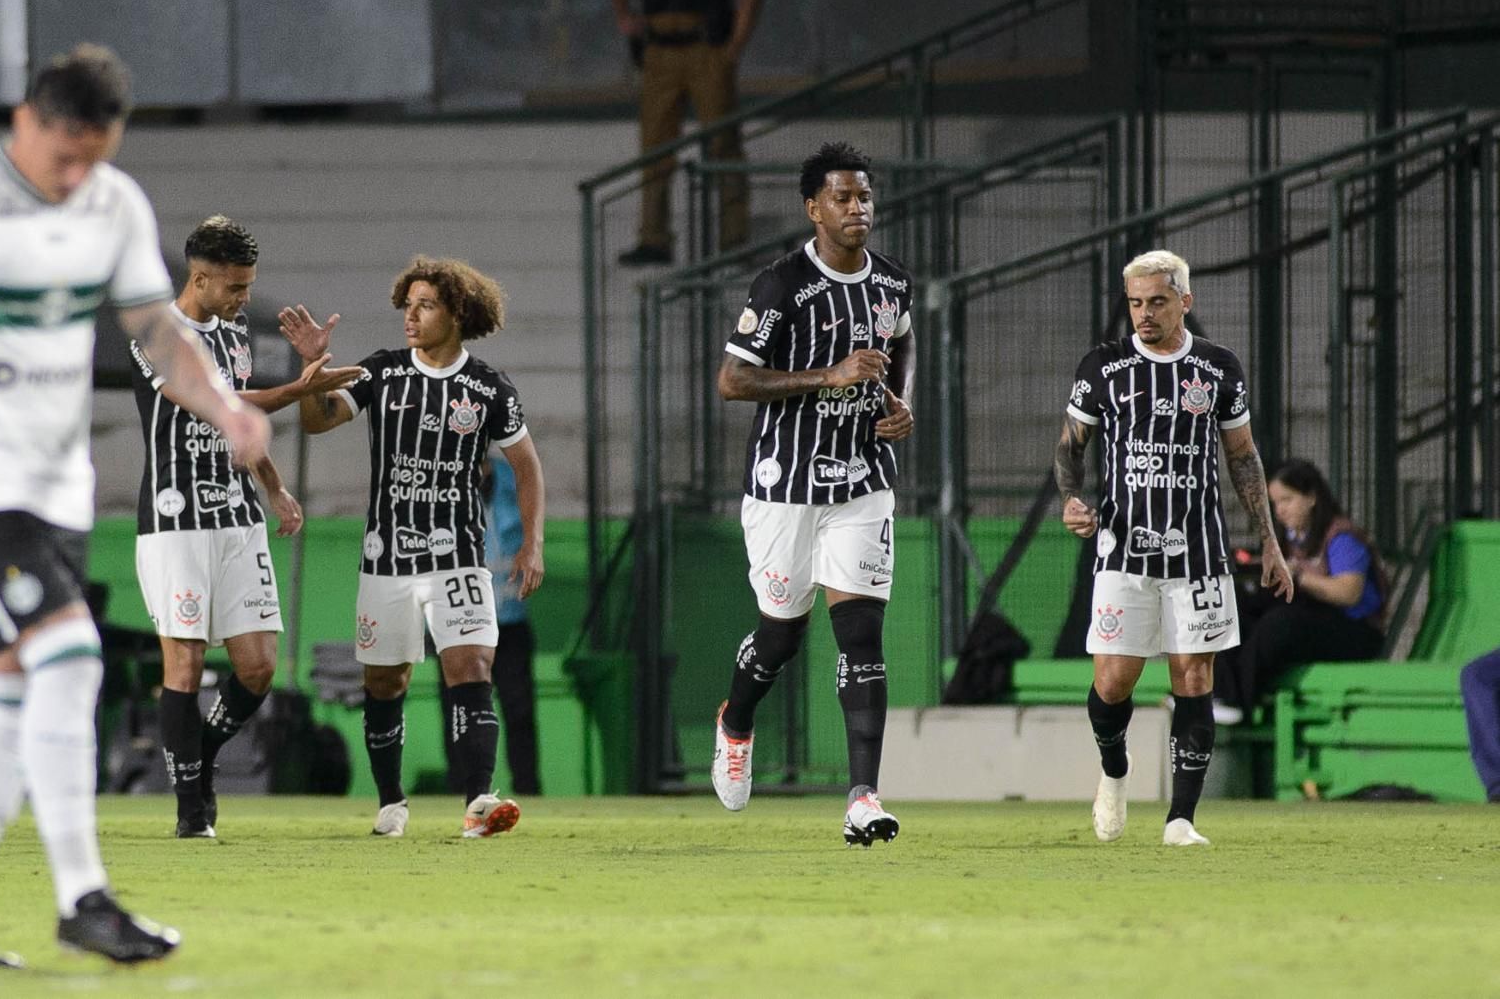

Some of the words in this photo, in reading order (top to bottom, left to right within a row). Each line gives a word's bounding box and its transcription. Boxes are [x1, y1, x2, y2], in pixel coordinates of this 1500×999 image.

[794, 277, 832, 307] pixbet
[871, 273, 908, 293] pixbet
[758, 308, 782, 343] bmg
[131, 347, 153, 378] bmg
[1101, 354, 1145, 379] pixbet
[1183, 354, 1225, 381] pixbet
[454, 373, 497, 400] pixbet
[817, 385, 858, 400] neo
[1125, 439, 1199, 455] vitaminas
[392, 453, 464, 472] vitaminas
[818, 463, 847, 479] Tele
[1125, 454, 1163, 470] neo
[391, 468, 426, 484] neo
[200, 489, 227, 503] Tele
[400, 535, 427, 549] Tele
[879, 518, 891, 555] 4
[1135, 535, 1161, 549] Tele
[256, 552, 272, 586] 5
[445, 573, 484, 608] 26
[1189, 575, 1222, 611] 23
